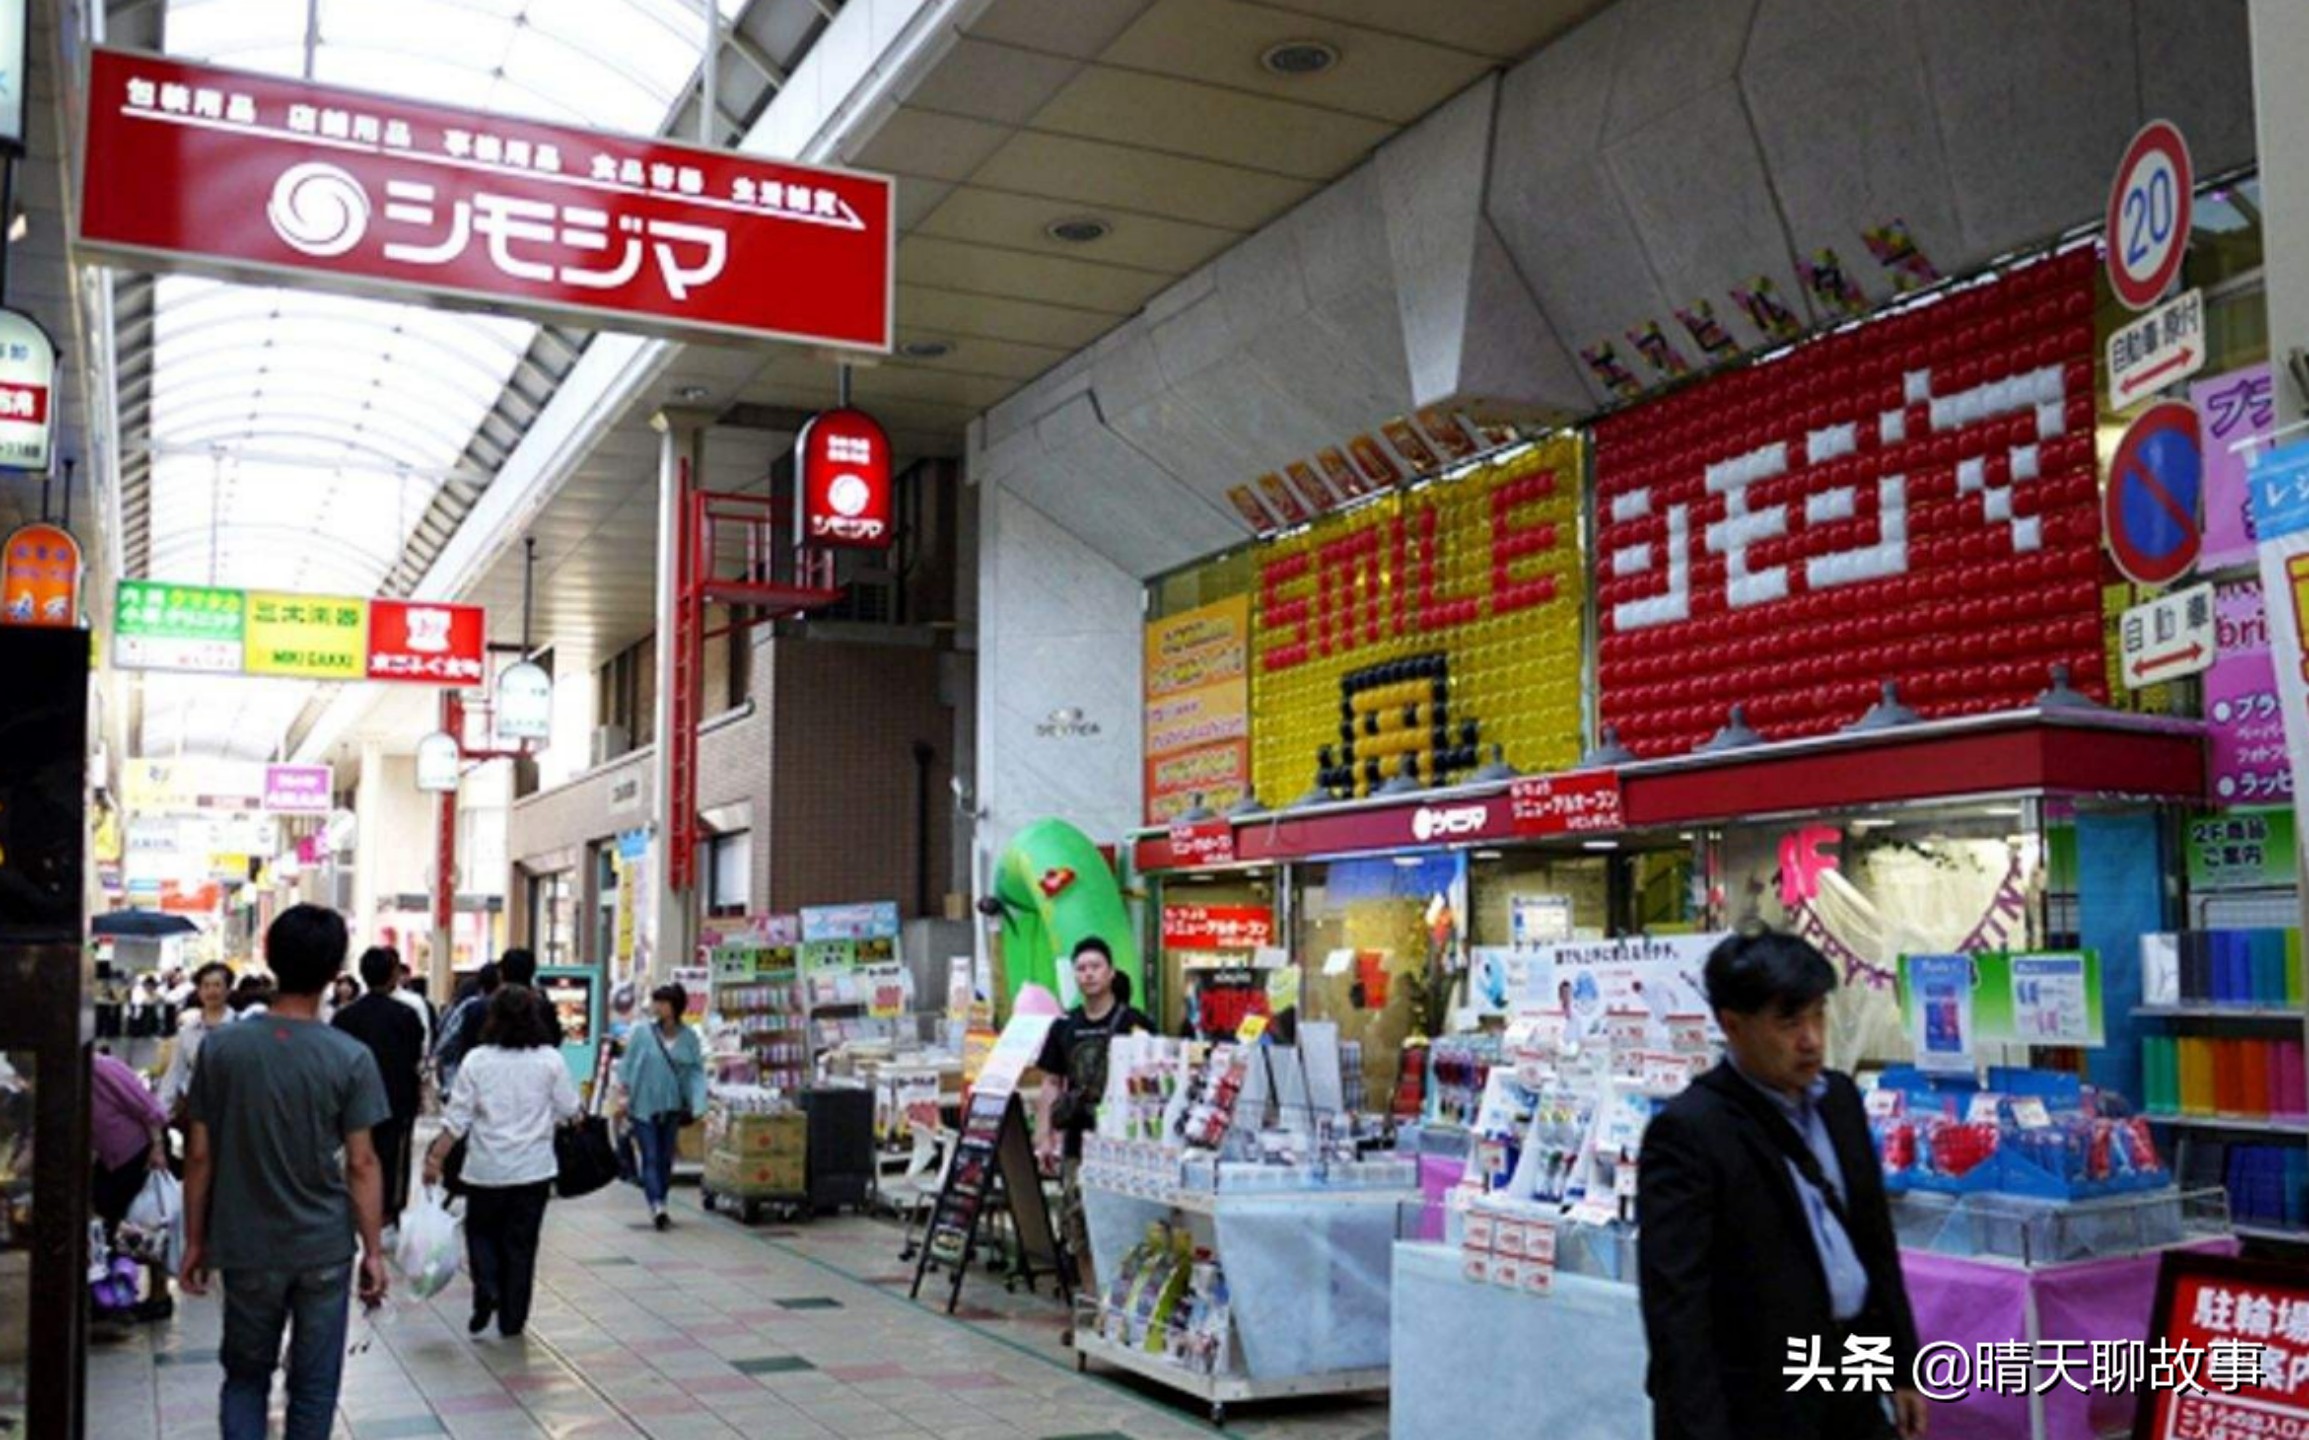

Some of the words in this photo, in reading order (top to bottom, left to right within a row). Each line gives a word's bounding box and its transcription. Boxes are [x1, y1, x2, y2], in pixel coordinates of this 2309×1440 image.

[384, 180, 727, 301] シモジマ
[2123, 167, 2172, 267] 20
[1612, 364, 2066, 632] シモジマ
[1263, 468, 1558, 672] SMILE
[2125, 594, 2209, 653] 自動車
